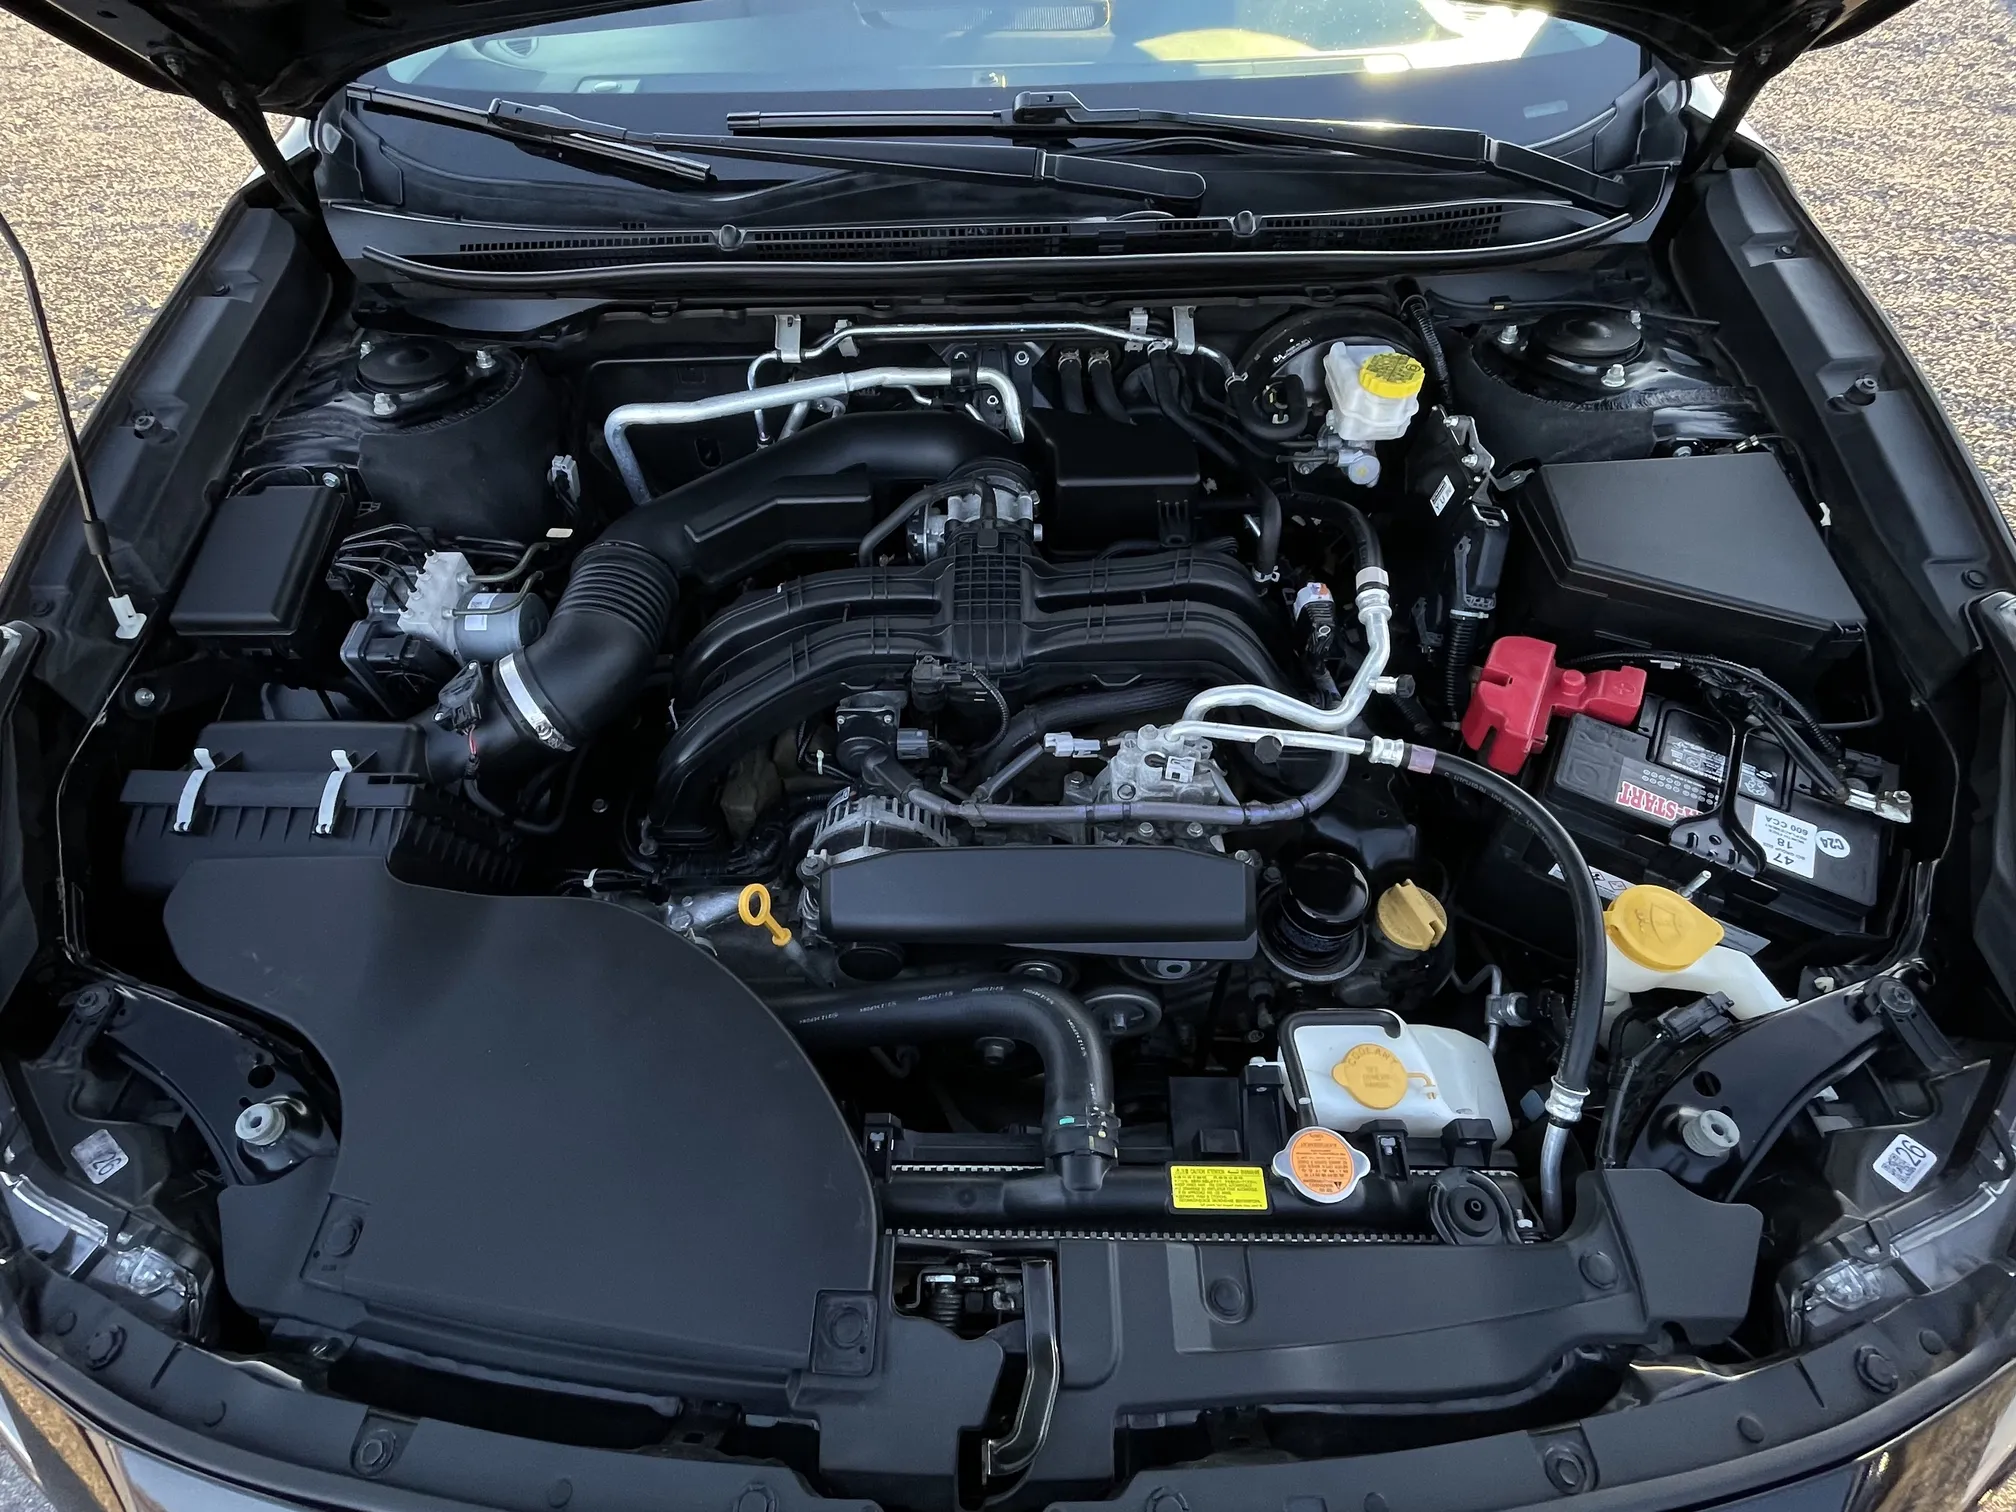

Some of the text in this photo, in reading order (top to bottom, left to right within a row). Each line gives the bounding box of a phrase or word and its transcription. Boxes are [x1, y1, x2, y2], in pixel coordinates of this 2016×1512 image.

[1765, 815, 1808, 836] 600 CCA
[1777, 837, 1793, 849] 18
[1773, 853, 1794, 865] 47
[1348, 1046, 1398, 1065] COOLANT
[1895, 1139, 1927, 1167] 26
[91, 1151, 122, 1176] 26
